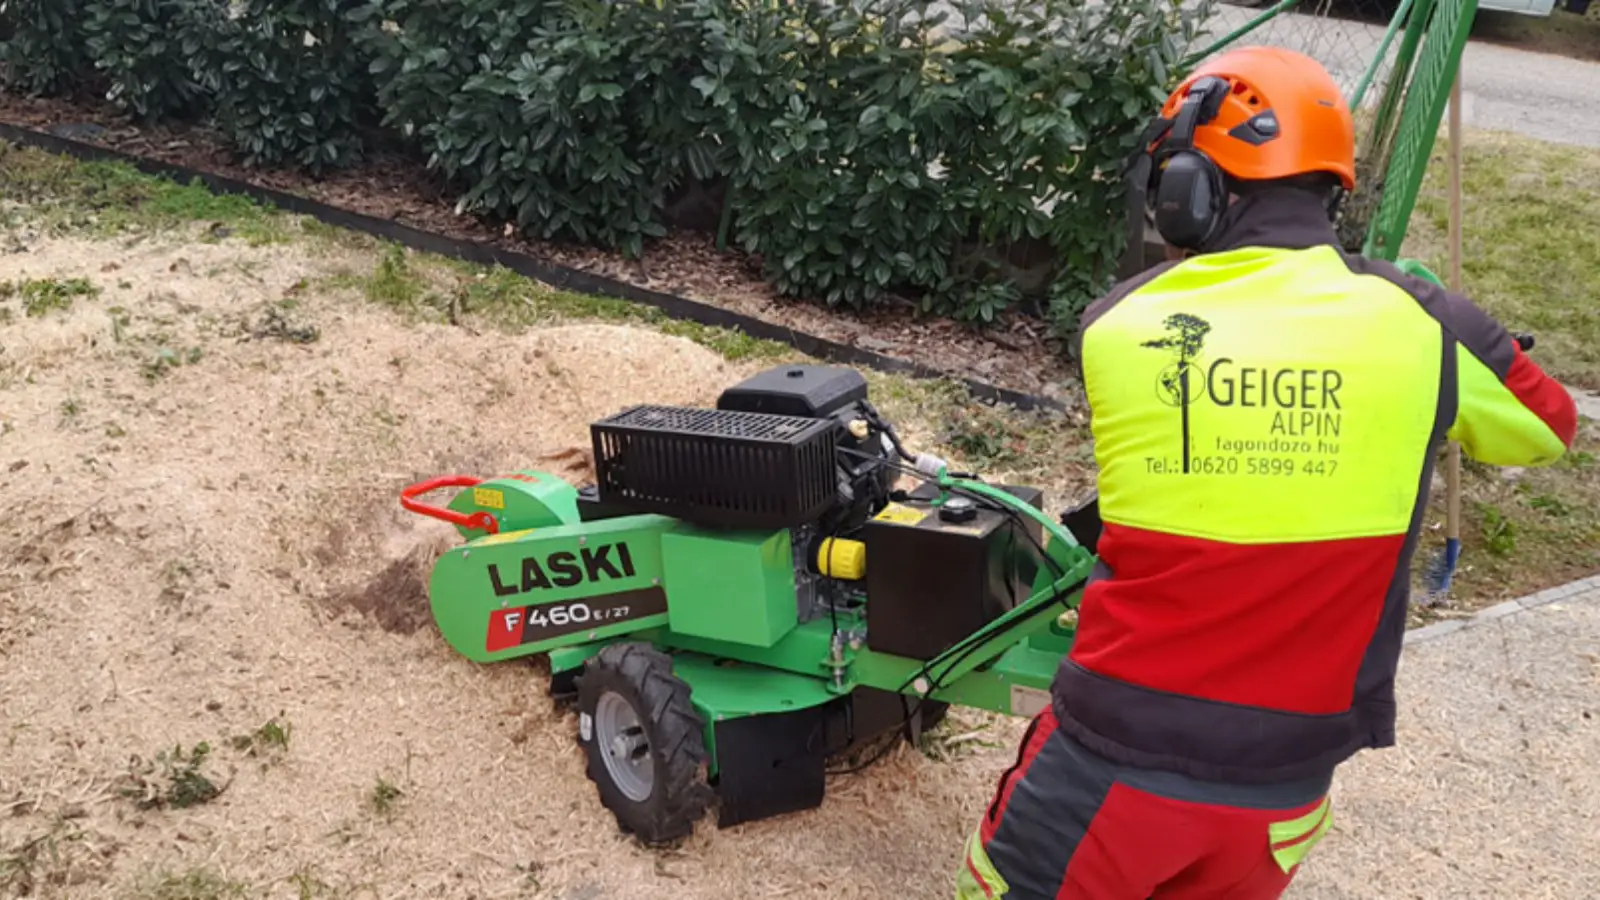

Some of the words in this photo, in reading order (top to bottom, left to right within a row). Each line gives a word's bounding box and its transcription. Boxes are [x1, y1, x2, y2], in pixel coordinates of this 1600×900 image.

[1207, 358, 1343, 410] GEIGER
[1269, 410, 1342, 437] ALPIN
[1191, 456, 1238, 475] 0620
[1246, 457, 1295, 476] 5899
[1301, 459, 1339, 477] 447
[487, 541, 637, 597] LASKI
[503, 611, 521, 632] F
